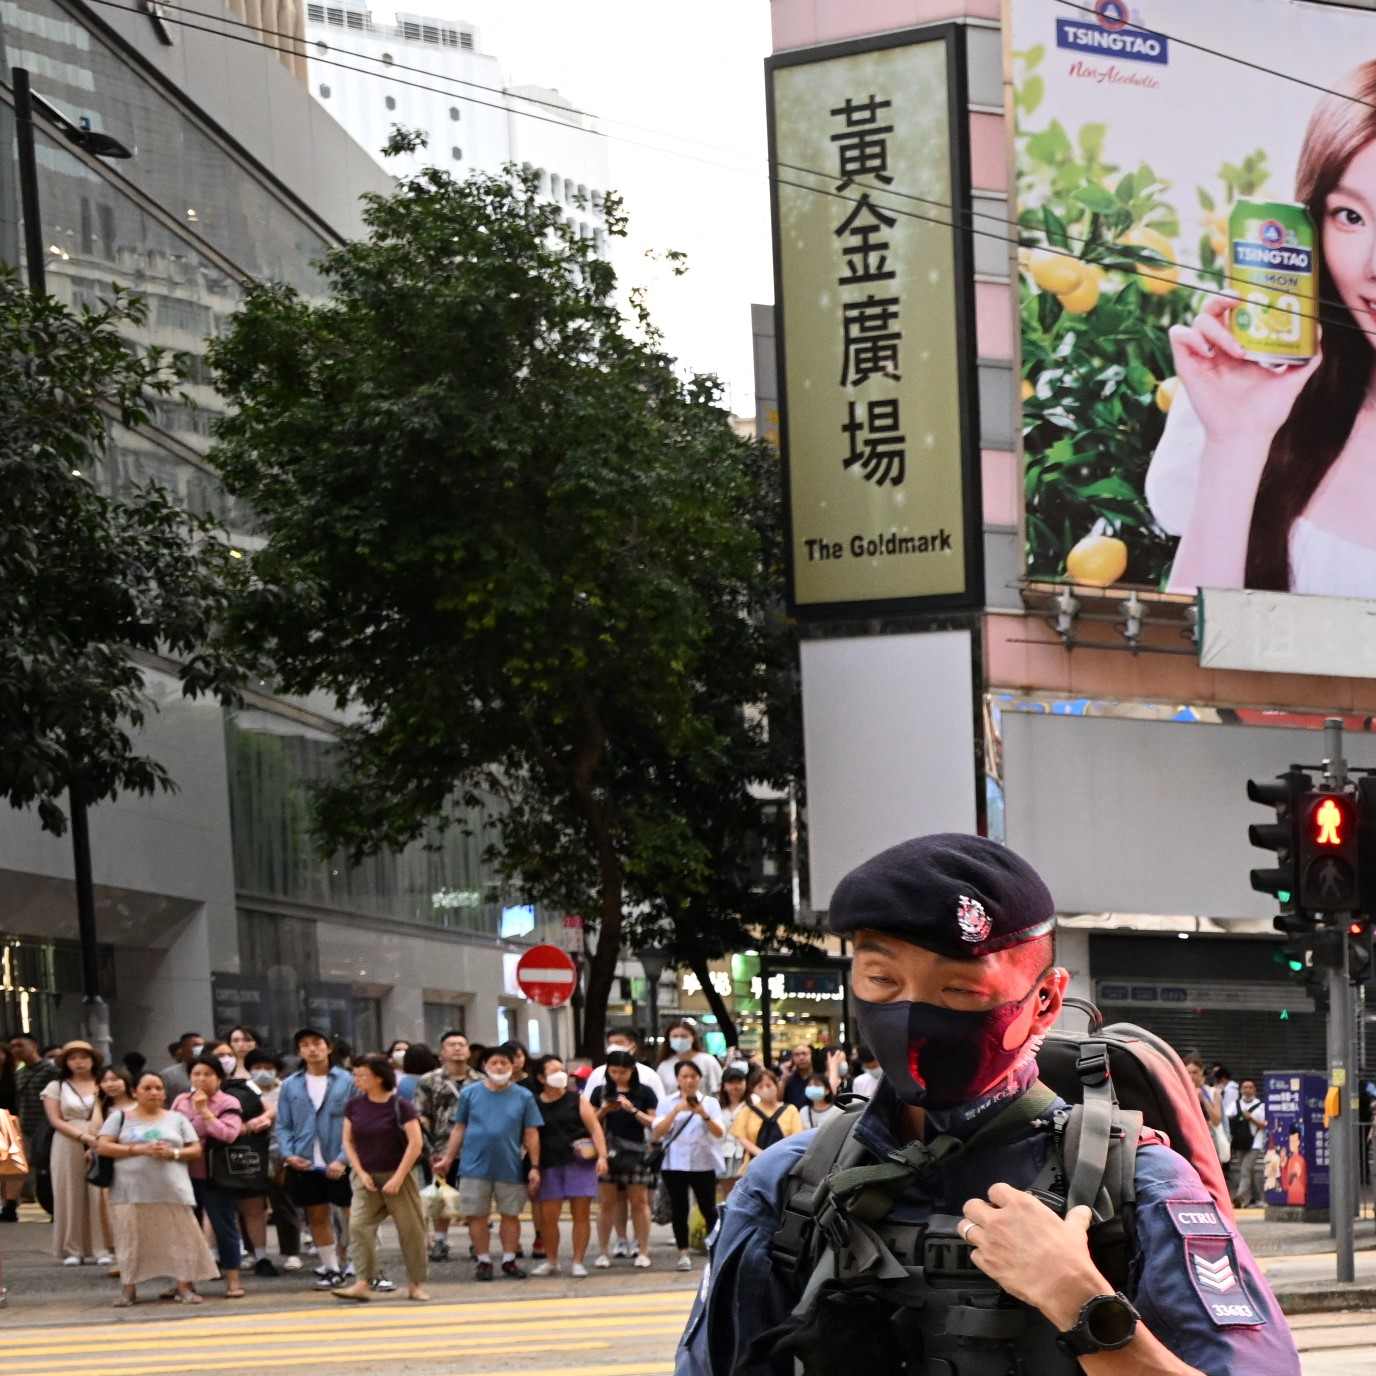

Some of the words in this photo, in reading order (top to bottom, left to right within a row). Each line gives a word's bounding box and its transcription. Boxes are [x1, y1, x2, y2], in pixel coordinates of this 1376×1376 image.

[1063, 26, 1161, 56] TSINGTAO
[1237, 247, 1309, 268] TSINGTAO
[829, 94, 907, 488] 黃金廣場
[804, 538, 843, 562] The
[850, 529, 952, 558] Goldmark
[1178, 1212, 1217, 1225] CTRU
